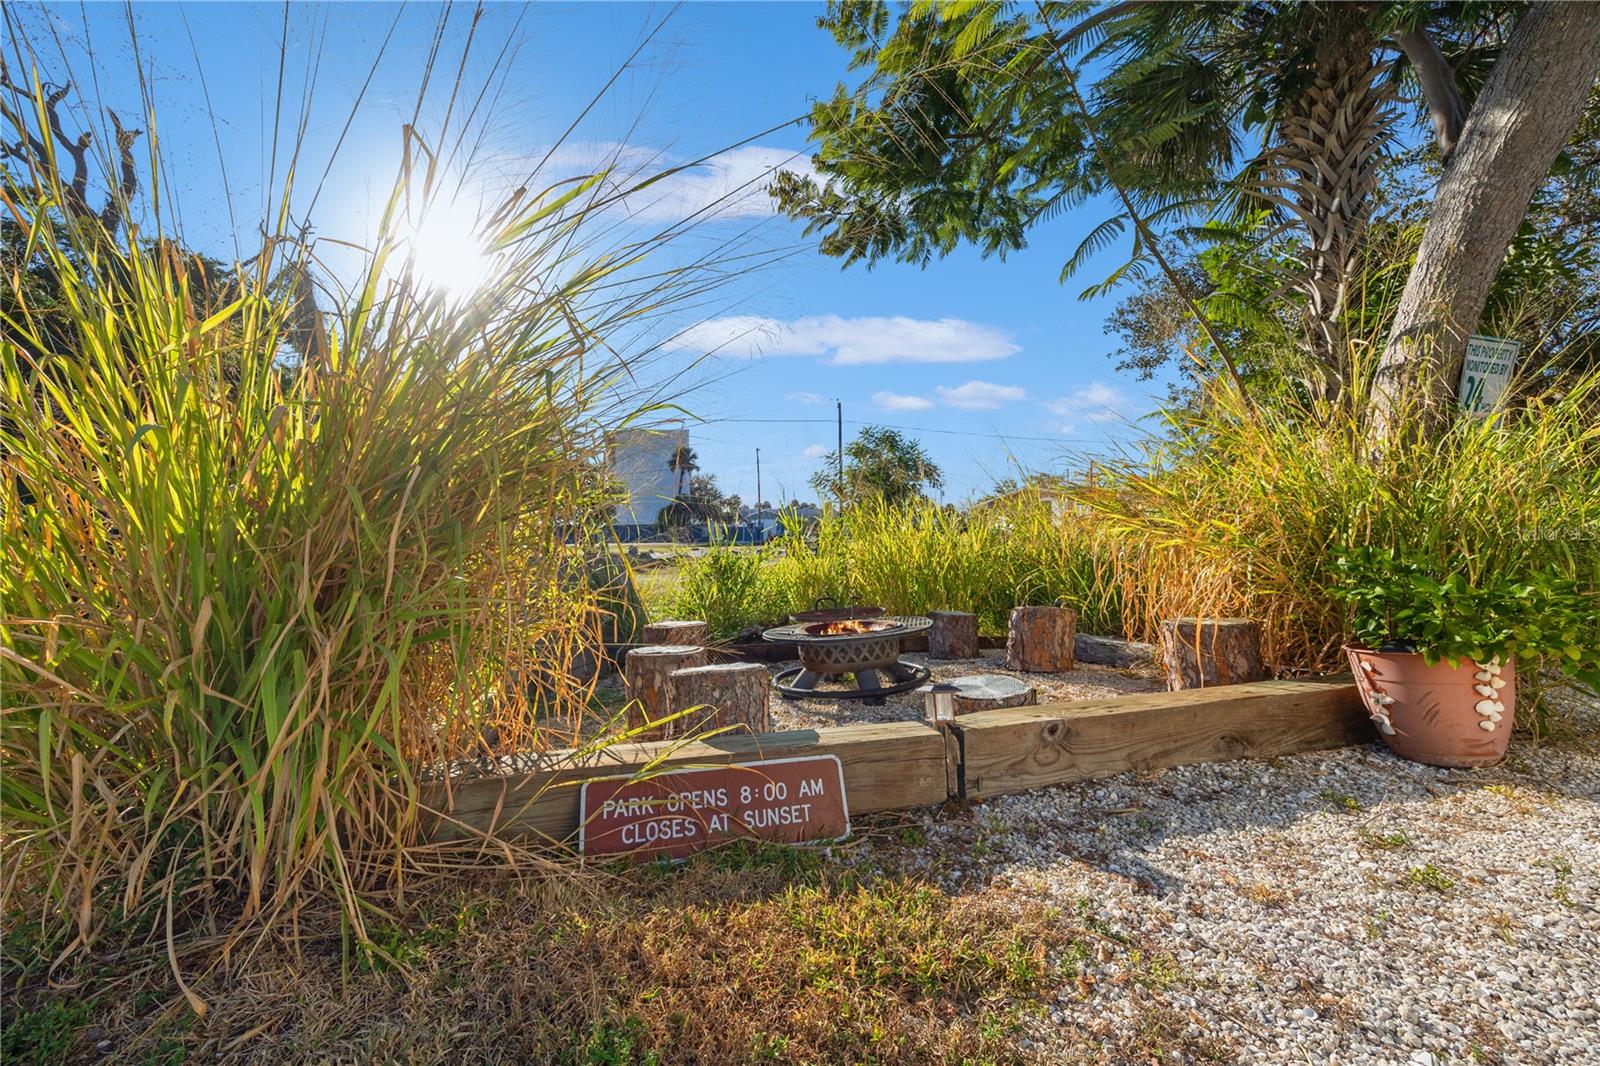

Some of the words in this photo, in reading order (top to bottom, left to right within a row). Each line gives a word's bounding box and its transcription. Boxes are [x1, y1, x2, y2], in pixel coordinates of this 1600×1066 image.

[1468, 344, 1482, 357] THIS
[1499, 363, 1510, 376] BY
[602, 798, 654, 820] PARK
[667, 788, 728, 813] OPENS
[739, 781, 787, 804] 8:00
[799, 778, 824, 797] AM
[621, 821, 696, 846] CLOSES
[709, 813, 730, 834] AT
[743, 803, 811, 830] SUNSET
